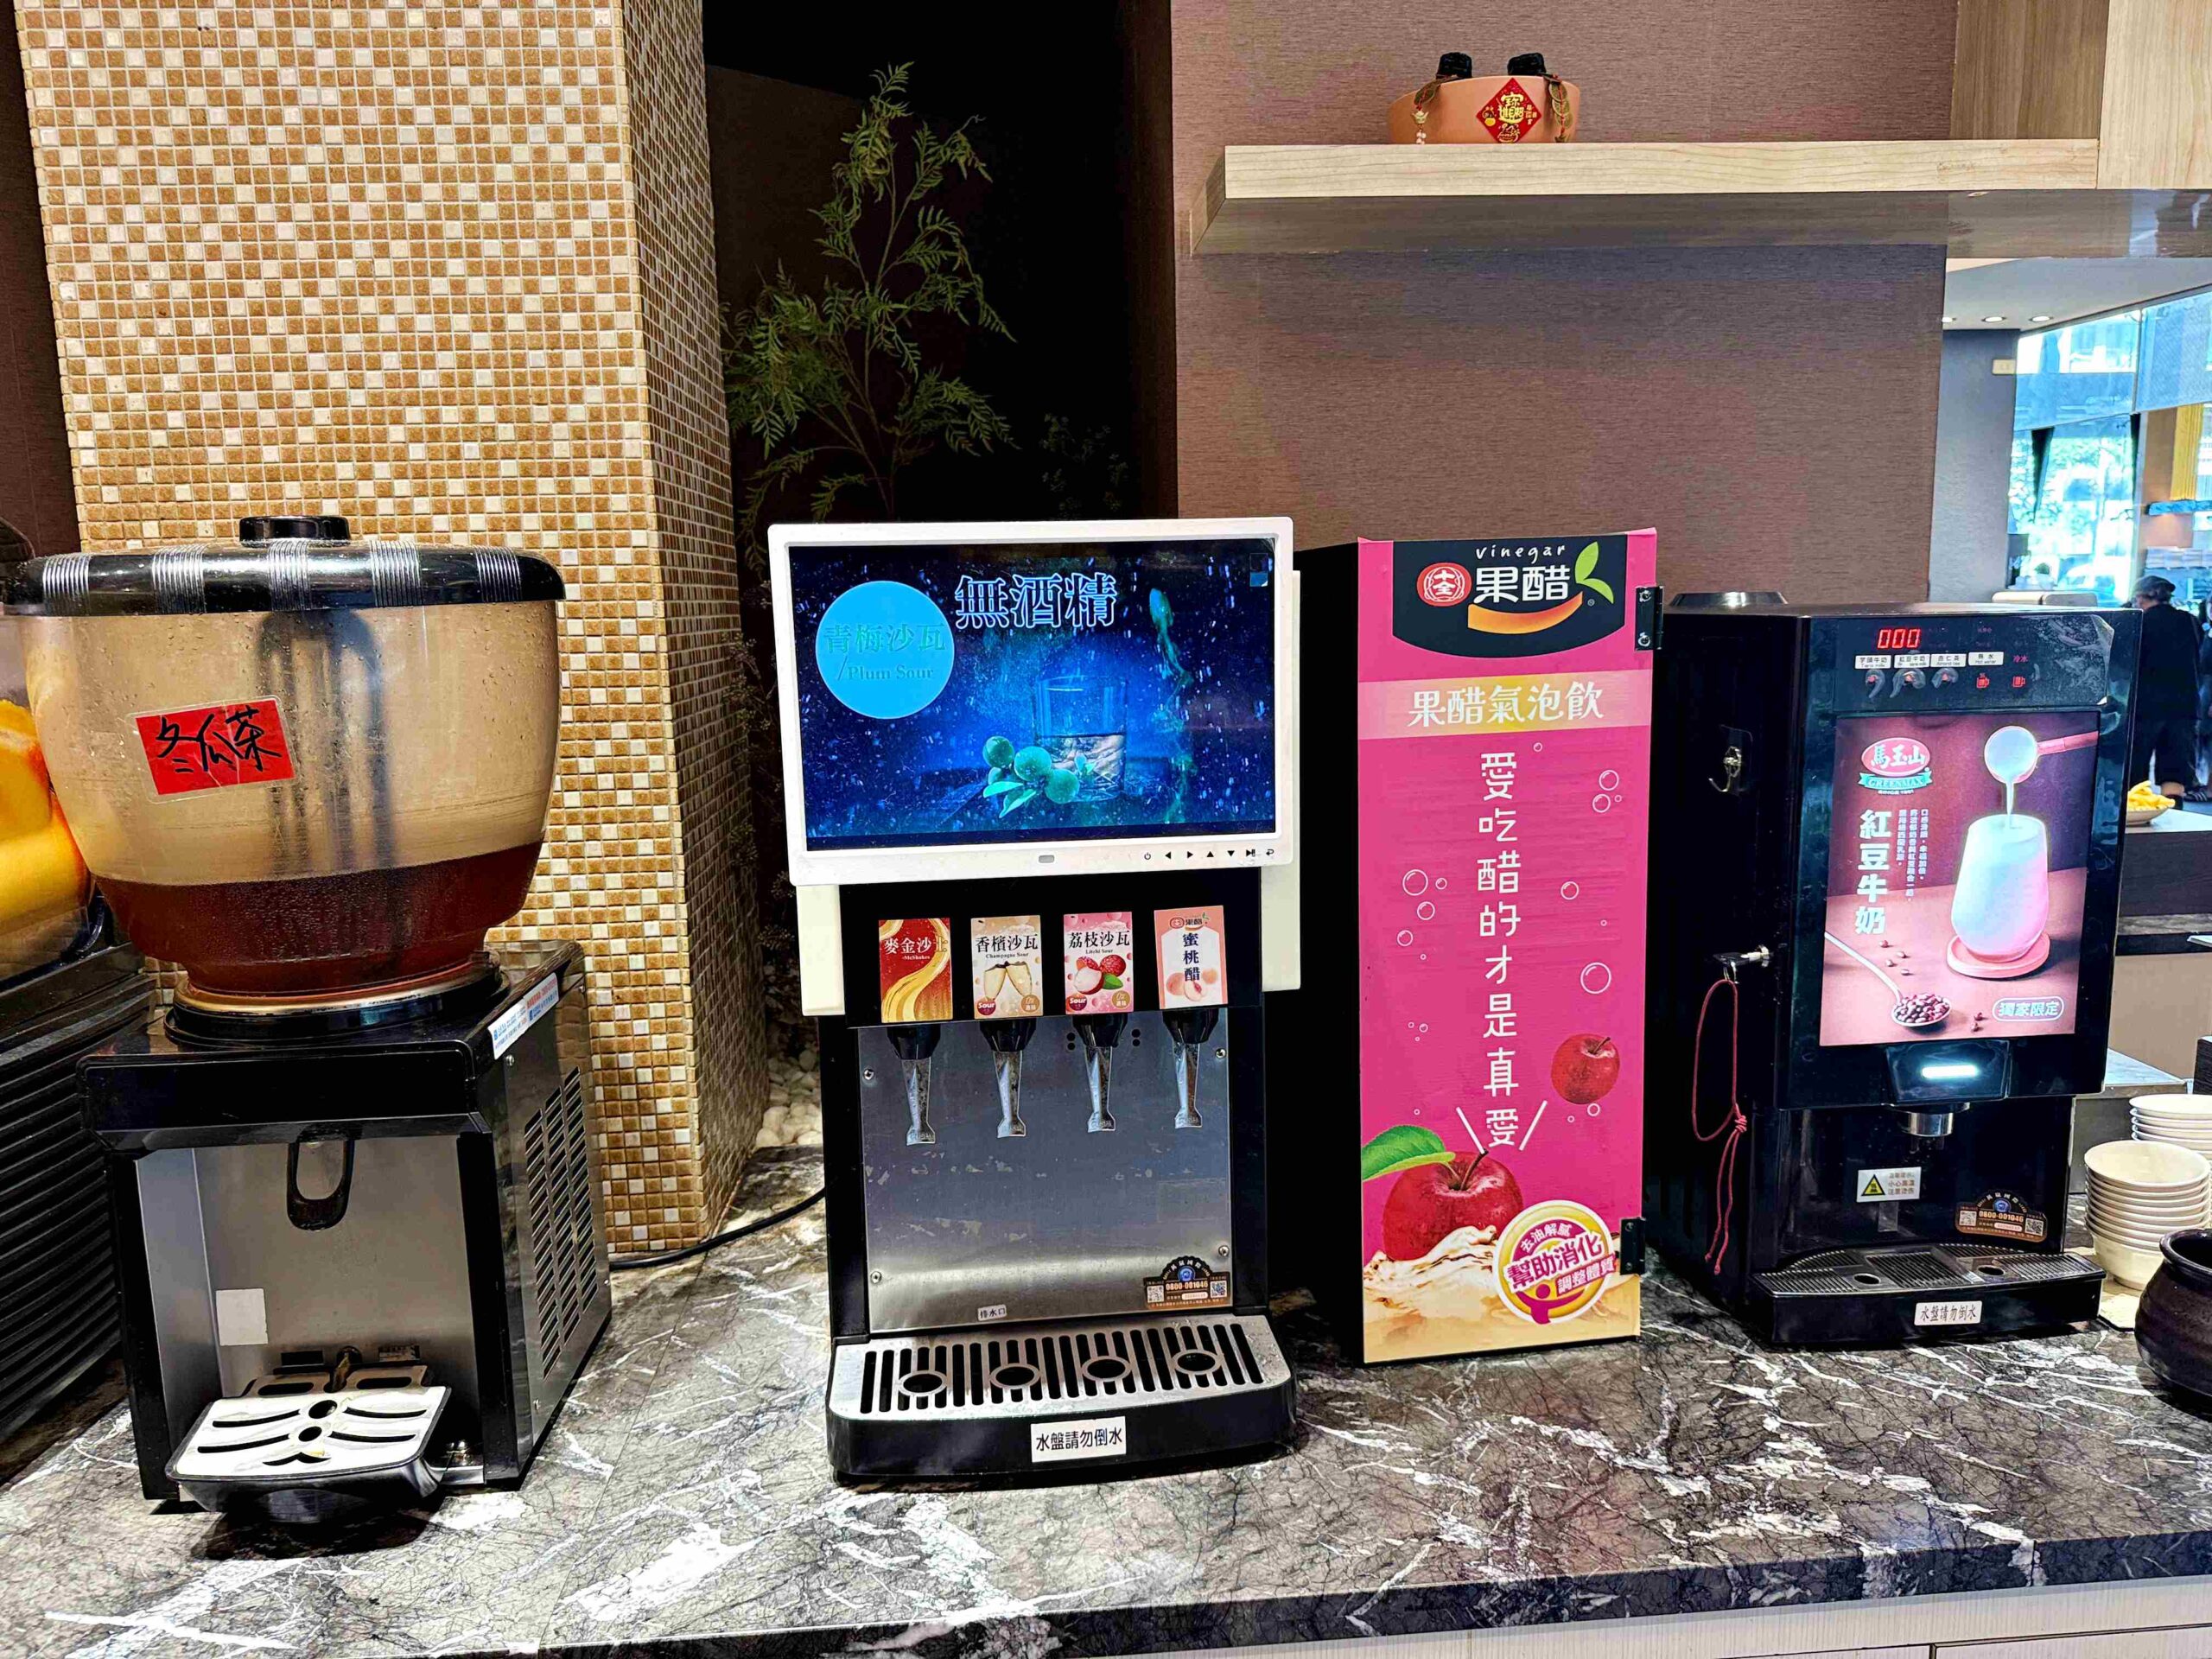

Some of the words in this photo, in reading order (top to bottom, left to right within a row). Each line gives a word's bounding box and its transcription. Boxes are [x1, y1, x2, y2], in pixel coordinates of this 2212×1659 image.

[1476, 544, 1566, 564] vinegar
[1473, 565, 1570, 603] 果醋
[955, 572, 1118, 628] 無酒精
[823, 622, 947, 654] 青梅沙瓦
[1877, 629, 1921, 649] 000
[896, 664, 934, 679] Sour
[1407, 680, 1605, 728] 果醋氣泡飲
[155, 705, 283, 772] 冬瓜茶
[1870, 744, 1926, 769] 馬玉山
[1867, 777, 1923, 788] GREENMAX
[1854, 809, 1892, 936] 紅豆牛奶
[976, 934, 1039, 953] 香檳沙瓦
[1068, 931, 1129, 948] 荔枝沙瓦
[1476, 751, 1522, 1148] 愛吃醋的才是真愛
[1182, 932, 1200, 982] 蜜桃醋
[1999, 1001, 2059, 1016] 獨家限定
[1507, 1234, 1602, 1289] 幫助消化
[1557, 1258, 1615, 1294] 調整體質
[1921, 1304, 1976, 1322] 水盤請勿倒水
[1035, 1427, 1123, 1452] 水盤請勿倒水
